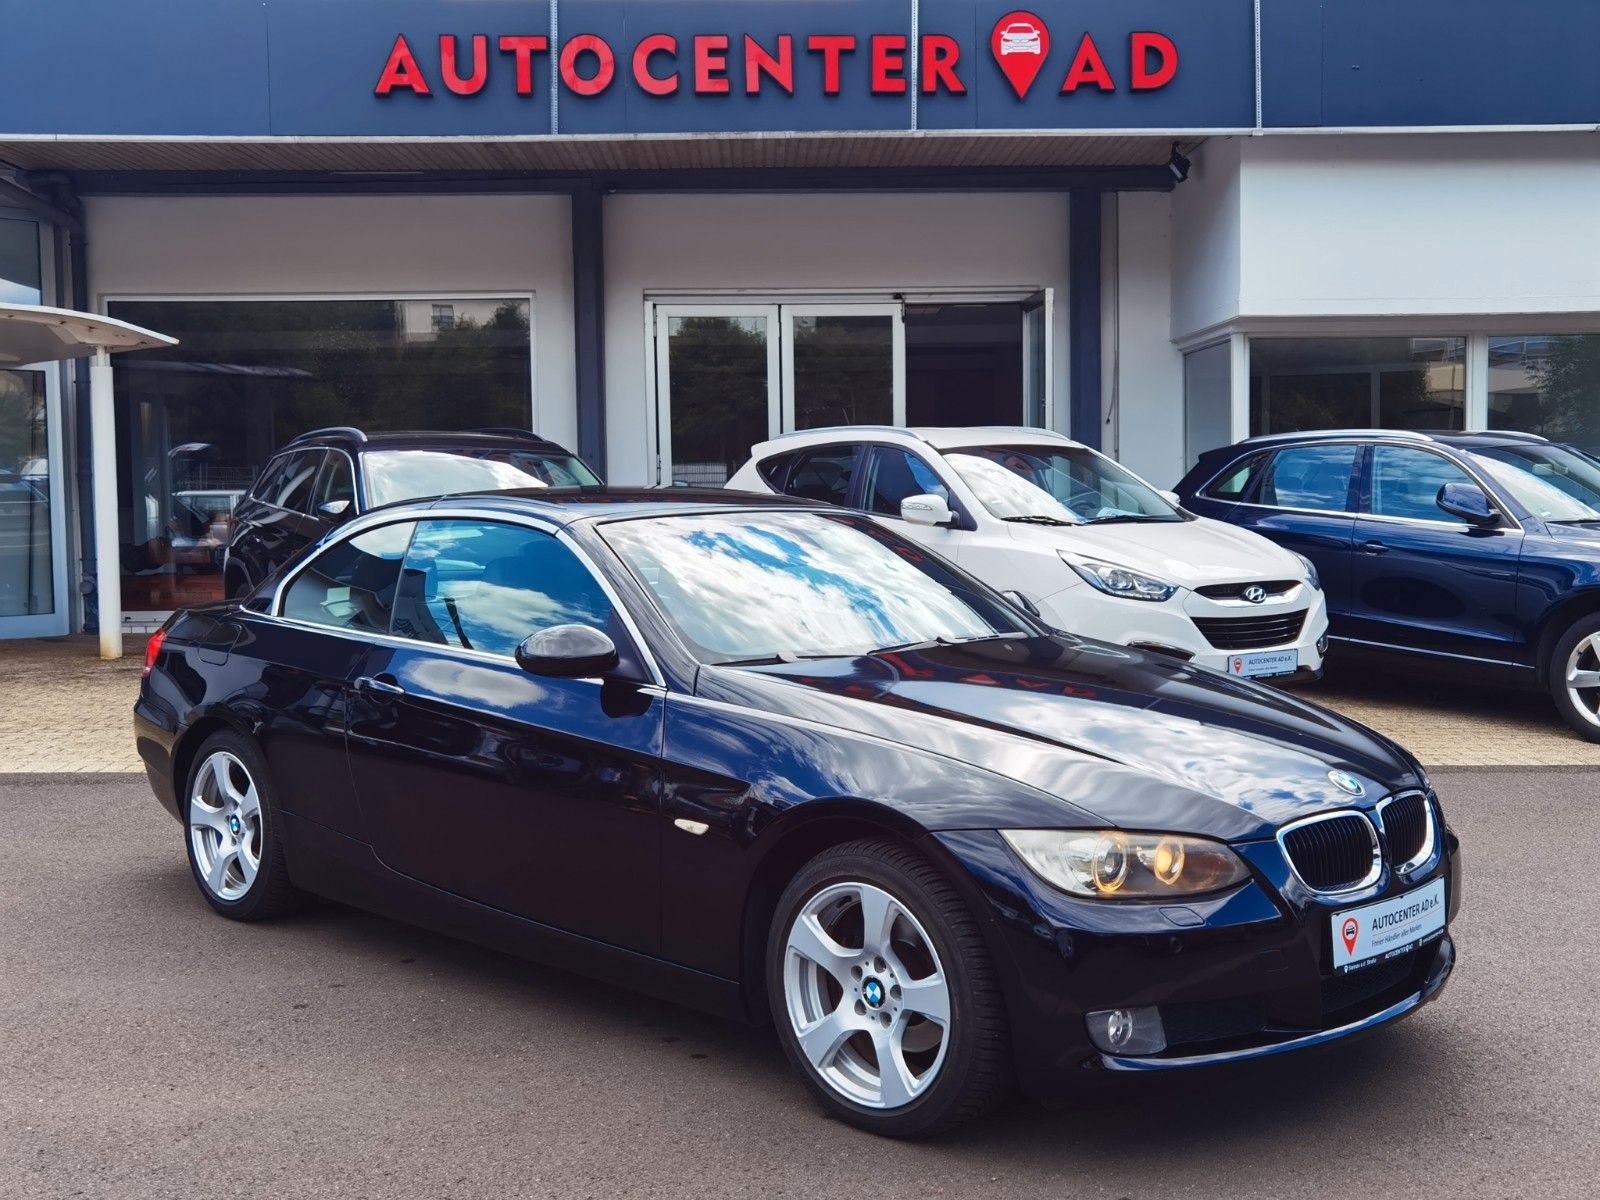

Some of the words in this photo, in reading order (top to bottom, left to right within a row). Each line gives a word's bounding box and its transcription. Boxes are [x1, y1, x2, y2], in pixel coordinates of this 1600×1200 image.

[374, 33, 967, 97] AUTOCENTER
[1059, 31, 1179, 94] AD
[1372, 904, 1420, 930] AUTOCENTER
[1421, 899, 1429, 912] AD
[1430, 894, 1439, 909] e.K.
